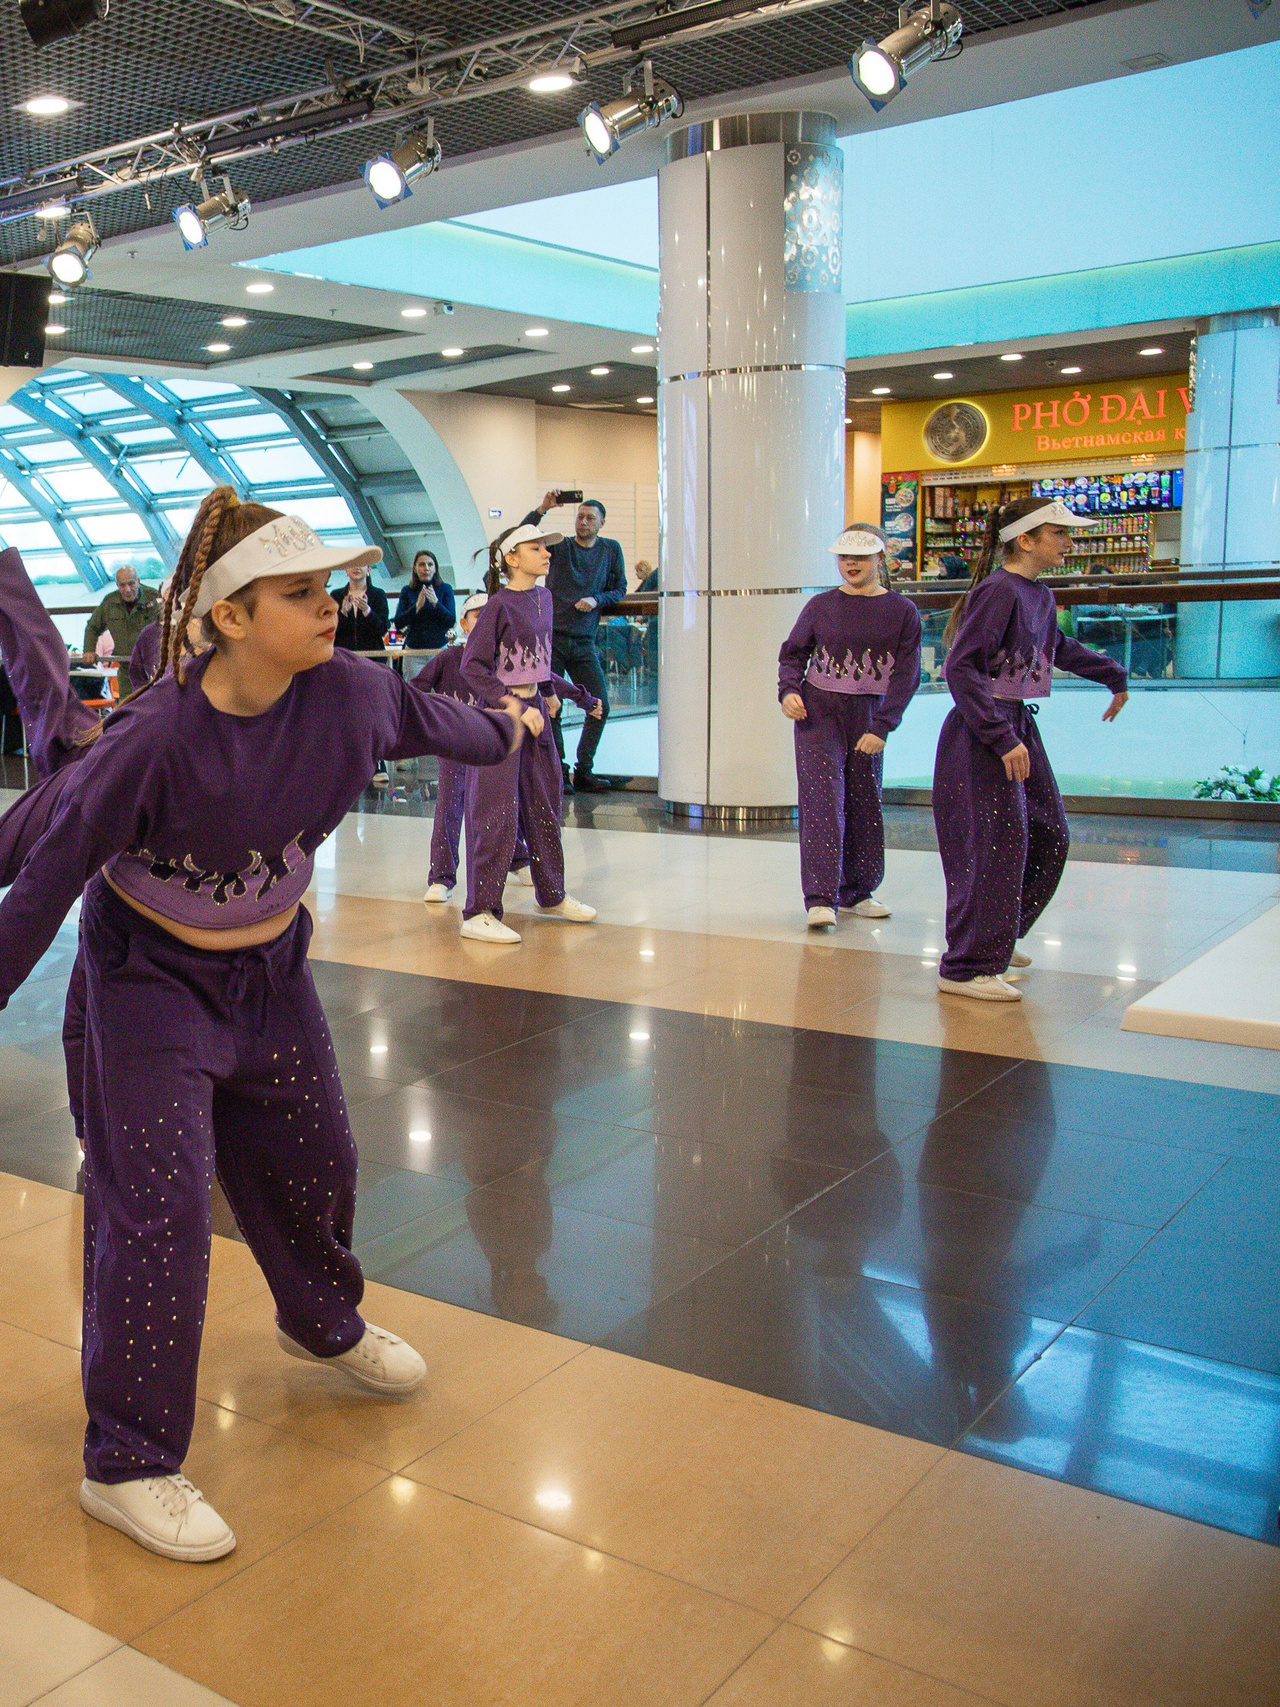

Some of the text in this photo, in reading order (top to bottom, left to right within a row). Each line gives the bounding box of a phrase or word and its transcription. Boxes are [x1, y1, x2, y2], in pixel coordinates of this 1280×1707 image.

[1011, 391, 1091, 431] PHỞ
[1098, 389, 1167, 425] ĐẠI
[1036, 428, 1166, 452] Вьетнамская
